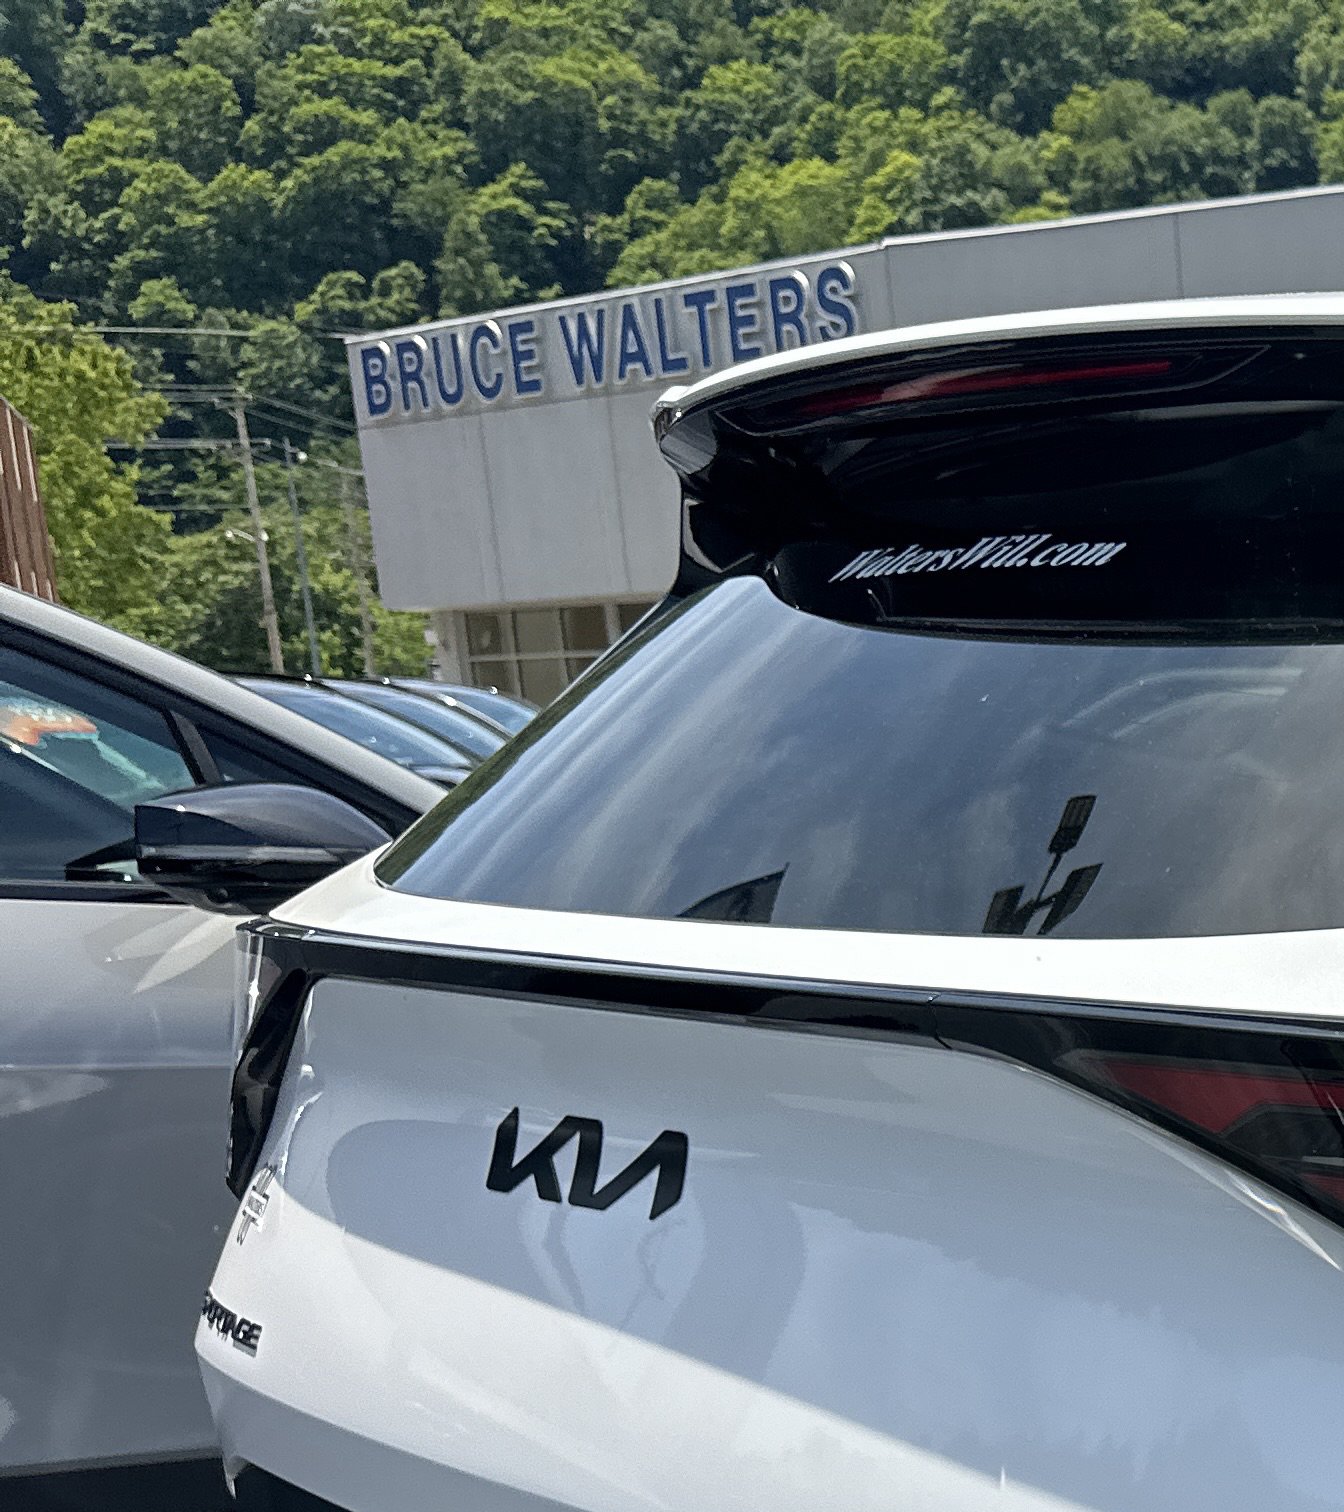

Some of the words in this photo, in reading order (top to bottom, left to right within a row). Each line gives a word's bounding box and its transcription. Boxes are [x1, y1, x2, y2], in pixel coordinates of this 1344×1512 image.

[361, 319, 542, 417] BRUCE
[558, 262, 857, 388] WALTERS
[827, 533, 1127, 583] WaltersWill.com
[485, 1106, 689, 1220] KIA
